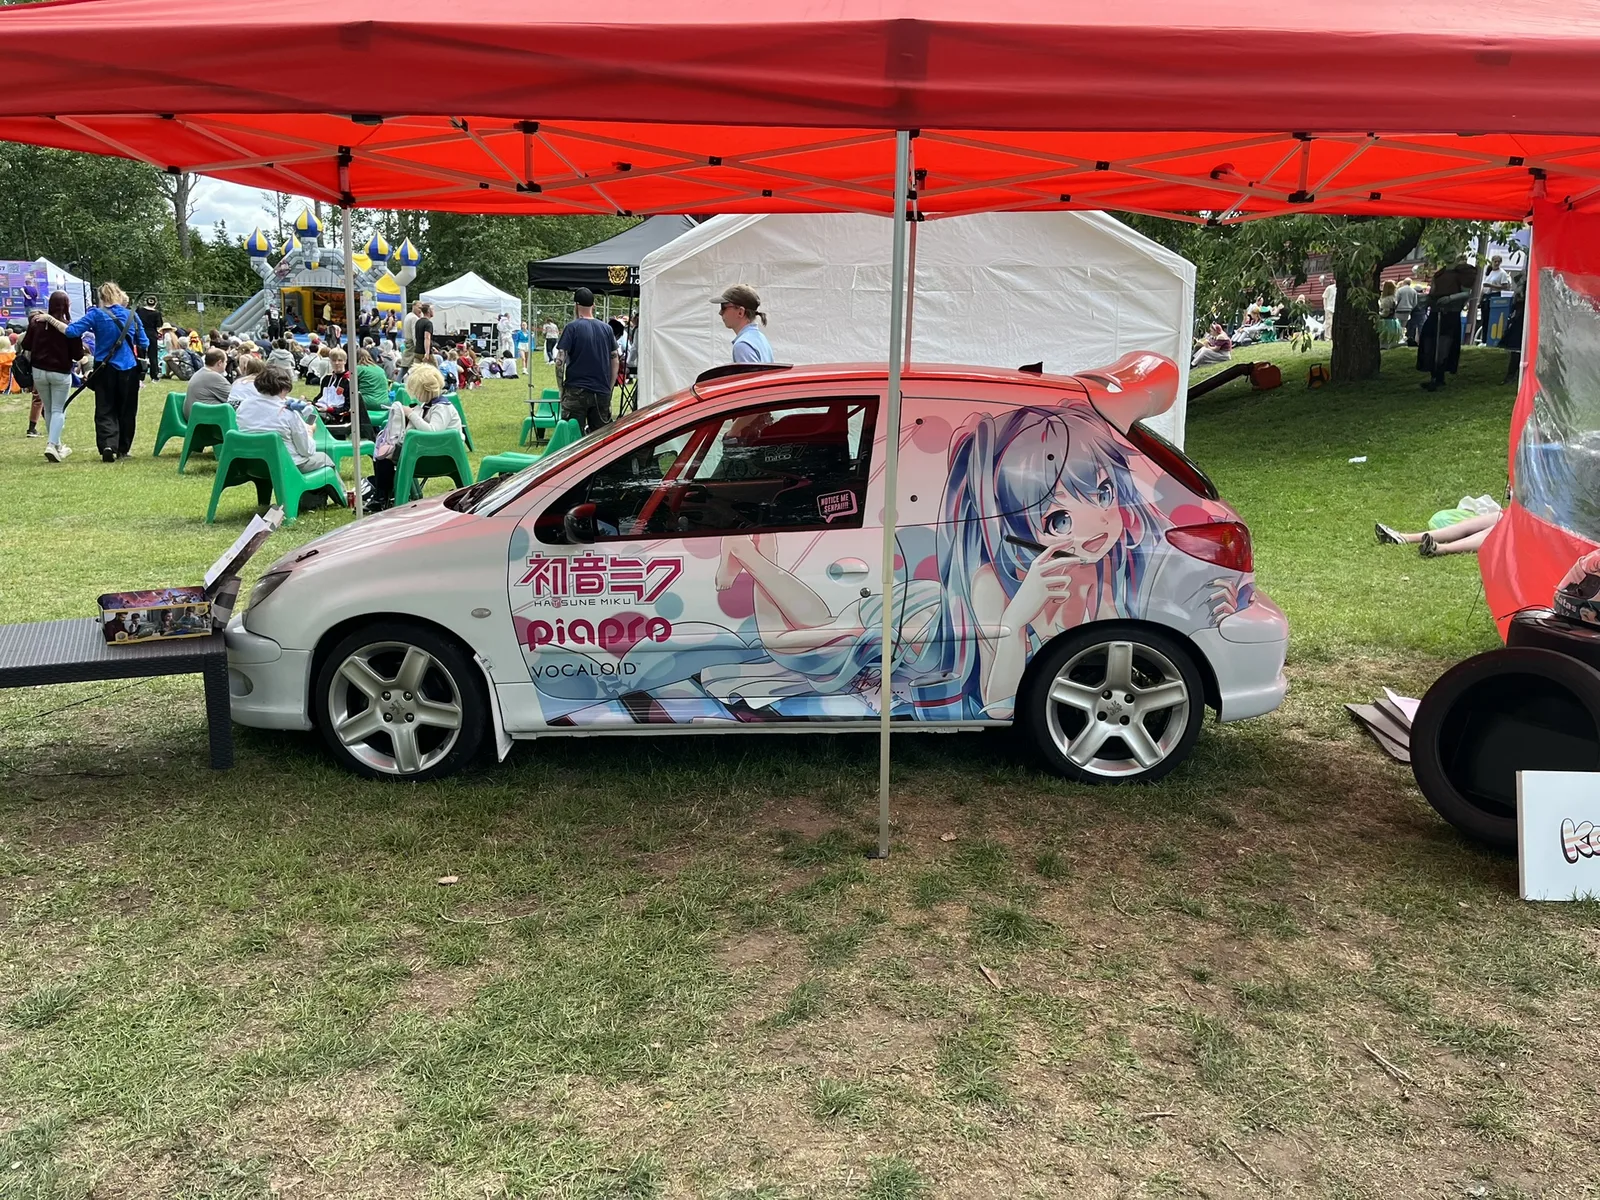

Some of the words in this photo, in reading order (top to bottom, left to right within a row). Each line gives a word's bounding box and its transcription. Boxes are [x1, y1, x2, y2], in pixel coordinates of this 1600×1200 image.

[821, 495, 840, 506] NOTICE
[840, 493, 849, 502] ME
[516, 551, 684, 604] 初音ミク
[534, 598, 596, 607] HATSUNE
[600, 598, 631, 606] MIKU
[527, 616, 672, 652] piapro
